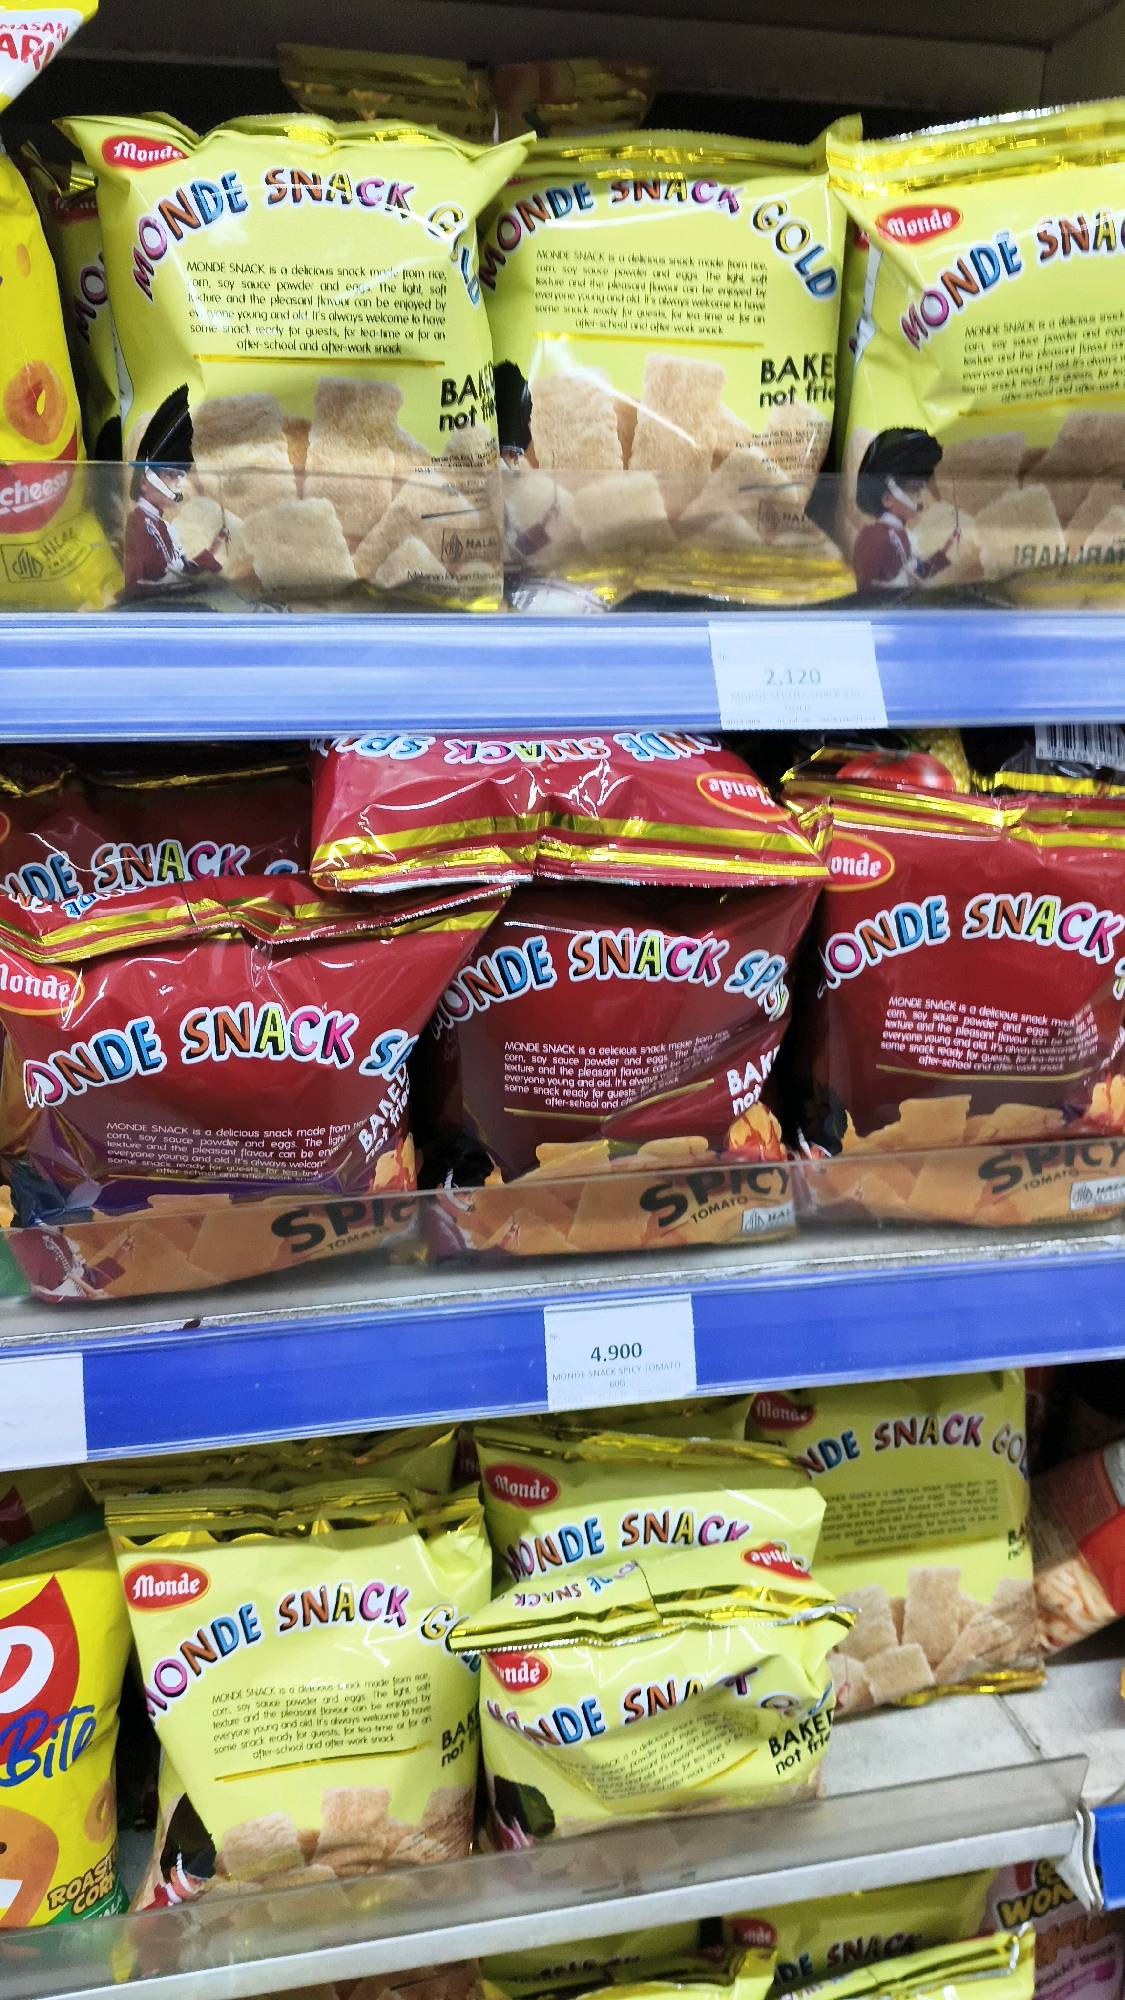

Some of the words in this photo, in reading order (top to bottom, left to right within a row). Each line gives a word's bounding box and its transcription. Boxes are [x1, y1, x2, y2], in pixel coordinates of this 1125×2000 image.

[133, 171, 248, 302] MONDE
[265, 168, 414, 218] SNACK
[886, 208, 953, 237] Monde
[480, 181, 593, 290] MONDE
[611, 179, 745, 214] SNACK
[753, 201, 838, 297] GOLD
[187, 261, 225, 273] MONDE
[230, 263, 265, 274] SNACK
[292, 264, 333, 276] delicious
[338, 264, 366, 276] snack
[900, 232, 1022, 352] MONDE
[1037, 210, 1125, 261] SNA
[218, 280, 234, 290] soy
[242, 280, 270, 289] sauce
[277, 280, 313, 292] powder
[320, 281, 339, 291] and
[226, 294, 245, 304] and
[250, 294, 265, 304] the
[270, 295, 313, 306] pleasant
[237, 310, 268, 321] young
[270, 310, 289, 320] and
[329, 311, 362, 324] always
[366, 313, 409, 324] welcome
[423, 314, 445, 325] have
[237, 338, 296, 351] after-school
[299, 341, 318, 351] and
[760, 353, 835, 385] BAKE
[760, 384, 796, 408] not
[440, 404, 477, 432] not
[764, 667, 822, 686] 2.120
[730, 691, 767, 701] MONDE
[448, 739, 610, 763] SNACK
[95, 840, 247, 889] SNACK
[831, 851, 882, 879] onde
[967, 898, 1121, 959] SNACK
[573, 933, 724, 983] SNACK
[183, 1006, 355, 1065] SNACK
[727, 1045, 780, 1097] BAK
[106, 1123, 147, 1131] MONDE
[151, 1125, 189, 1134] SNACK
[216, 1129, 259, 1138] delicious
[263, 1129, 293, 1138] snack
[297, 1127, 325, 1137] made
[329, 1124, 350, 1136] from
[107, 1132, 131, 1140] corn,
[200, 1138, 239, 1147] powder
[245, 1139, 264, 1147] and
[271, 1140, 297, 1149] eggs.
[305, 1138, 322, 1147] The
[107, 1149, 154, 1159] everyone
[158, 1153, 188, 1162] young
[192, 1154, 210, 1162] and
[251, 1158, 286, 1168] always
[171, 1144, 188, 1152] the
[192, 1146, 236, 1156] pleasant
[241, 1148, 274, 1158] flavour
[279, 1150, 296, 1158] can
[1023, 1168, 1079, 1191] TOMATO
[690, 1195, 748, 1224] TOMATO
[590, 1342, 643, 1362] 4.900
[552, 1371, 584, 1382] MONDE
[588, 1367, 616, 1378] SNACK
[618, 1364, 641, 1375] SPICY
[645, 1360, 681, 1372] TOMATO
[874, 1414, 984, 1452] SNACK
[494, 1471, 551, 1501] Monde
[505, 1517, 605, 1583] MONDE
[621, 1510, 751, 1546] SNACK
[133, 1570, 201, 1600] Monde
[279, 1582, 409, 1633] SNACK
[441, 1738, 465, 1767] not
[776, 1748, 801, 1776] not
